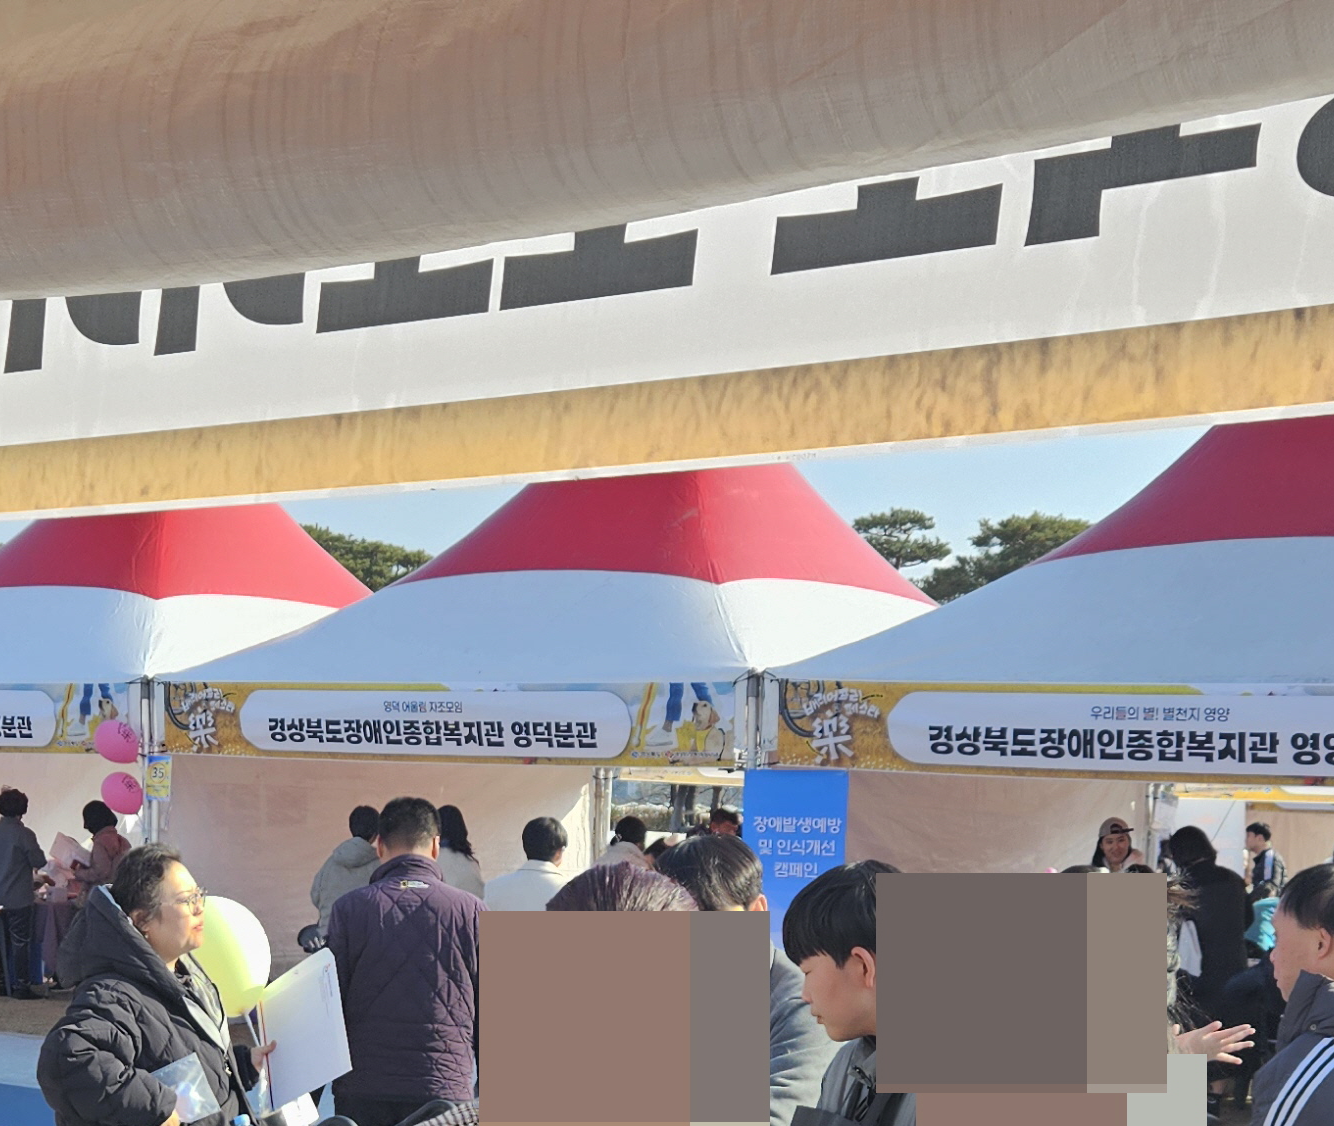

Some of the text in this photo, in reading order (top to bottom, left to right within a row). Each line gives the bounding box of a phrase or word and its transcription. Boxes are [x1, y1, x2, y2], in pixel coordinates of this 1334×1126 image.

[383, 701, 463, 713] 영덕 어울림 자조모임
[1090, 706, 1140, 721] 우리들의
[1162, 707, 1200, 722] 별천지
[1204, 707, 1230, 722] 영양
[269, 718, 598, 748] 경상북도장애인종합복지관 영덕분관
[929, 725, 1279, 764] 경상북도장애인종합복지관
[152, 766, 164, 779] 35
[753, 816, 842, 833] 장애발생예방
[758, 840, 836, 856] 및 인식개선
[774, 862, 818, 879] 캠페인
